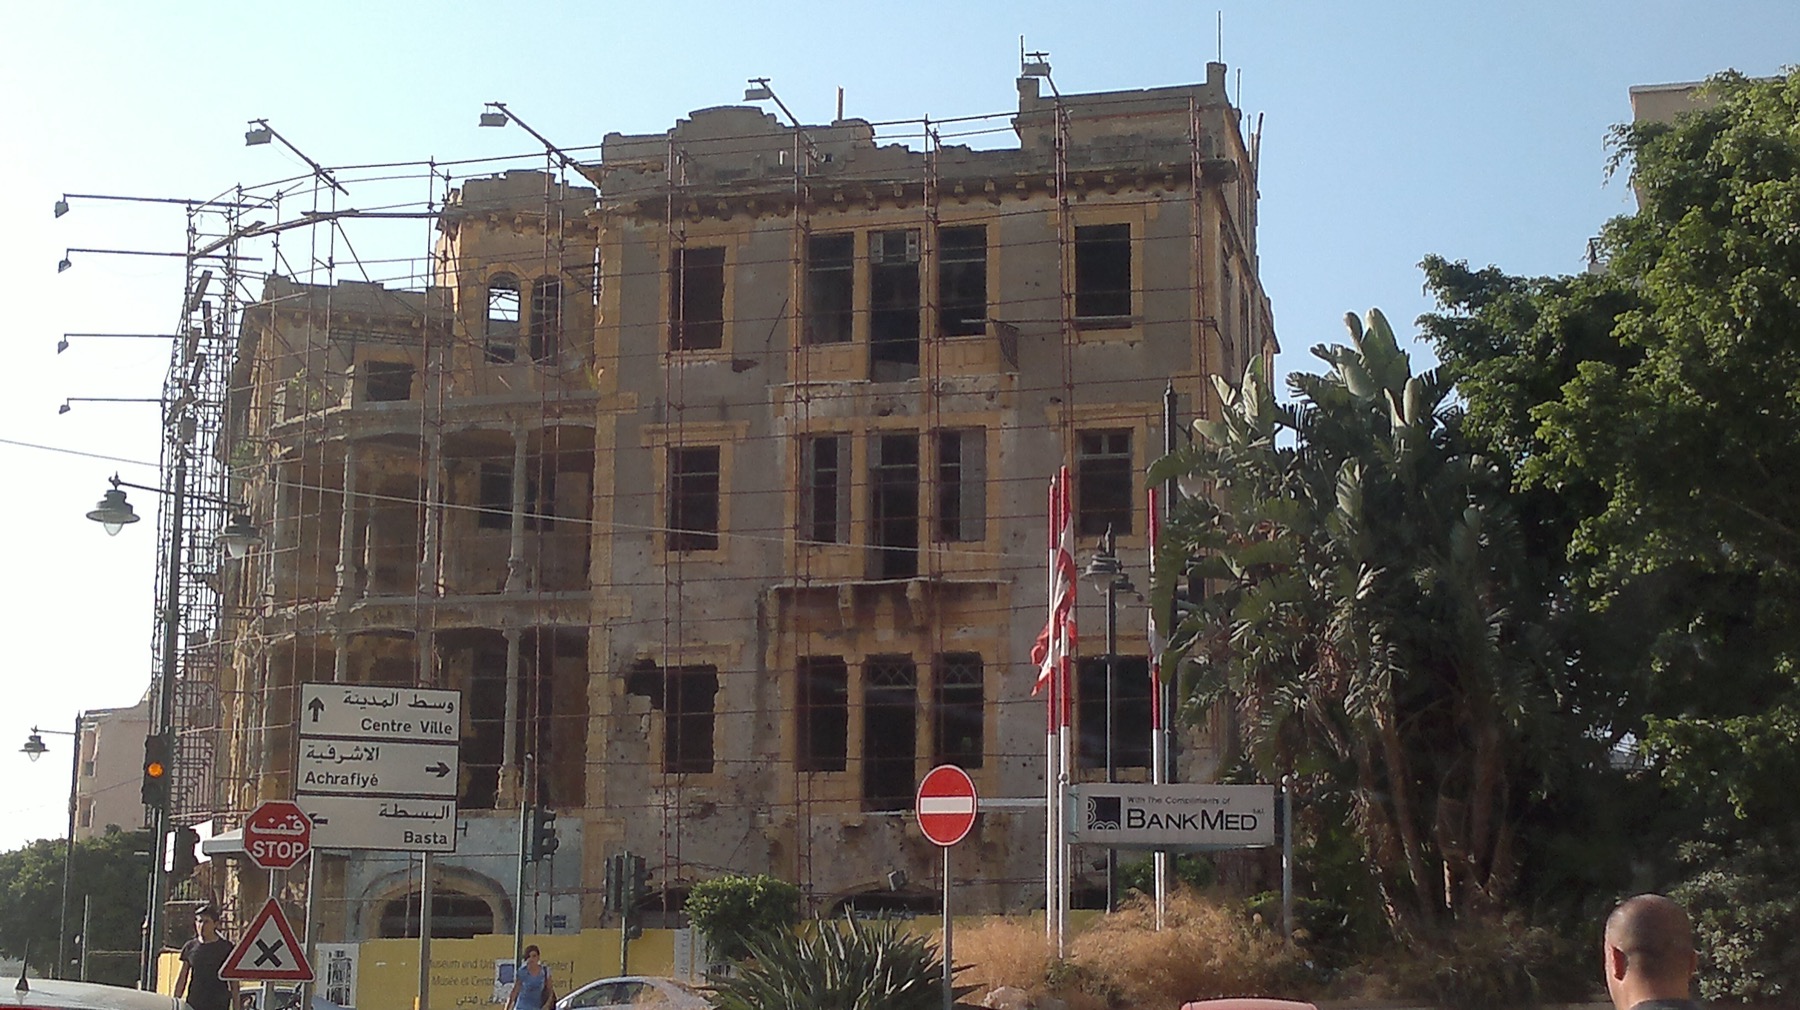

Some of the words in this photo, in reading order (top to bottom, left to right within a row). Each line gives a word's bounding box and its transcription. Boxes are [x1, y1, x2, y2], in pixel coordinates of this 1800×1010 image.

[343, 690, 399, 709] المدينة
[407, 694, 454, 713] وسط
[361, 718, 412, 733] Centre
[420, 721, 453, 734] Ville
[306, 744, 379, 764] الاشرفية
[305, 771, 379, 788] Achrafiyé
[379, 803, 449, 824] البسطة
[250, 815, 306, 836] قف
[404, 831, 448, 845] Basta
[252, 841, 304, 859] STOP
